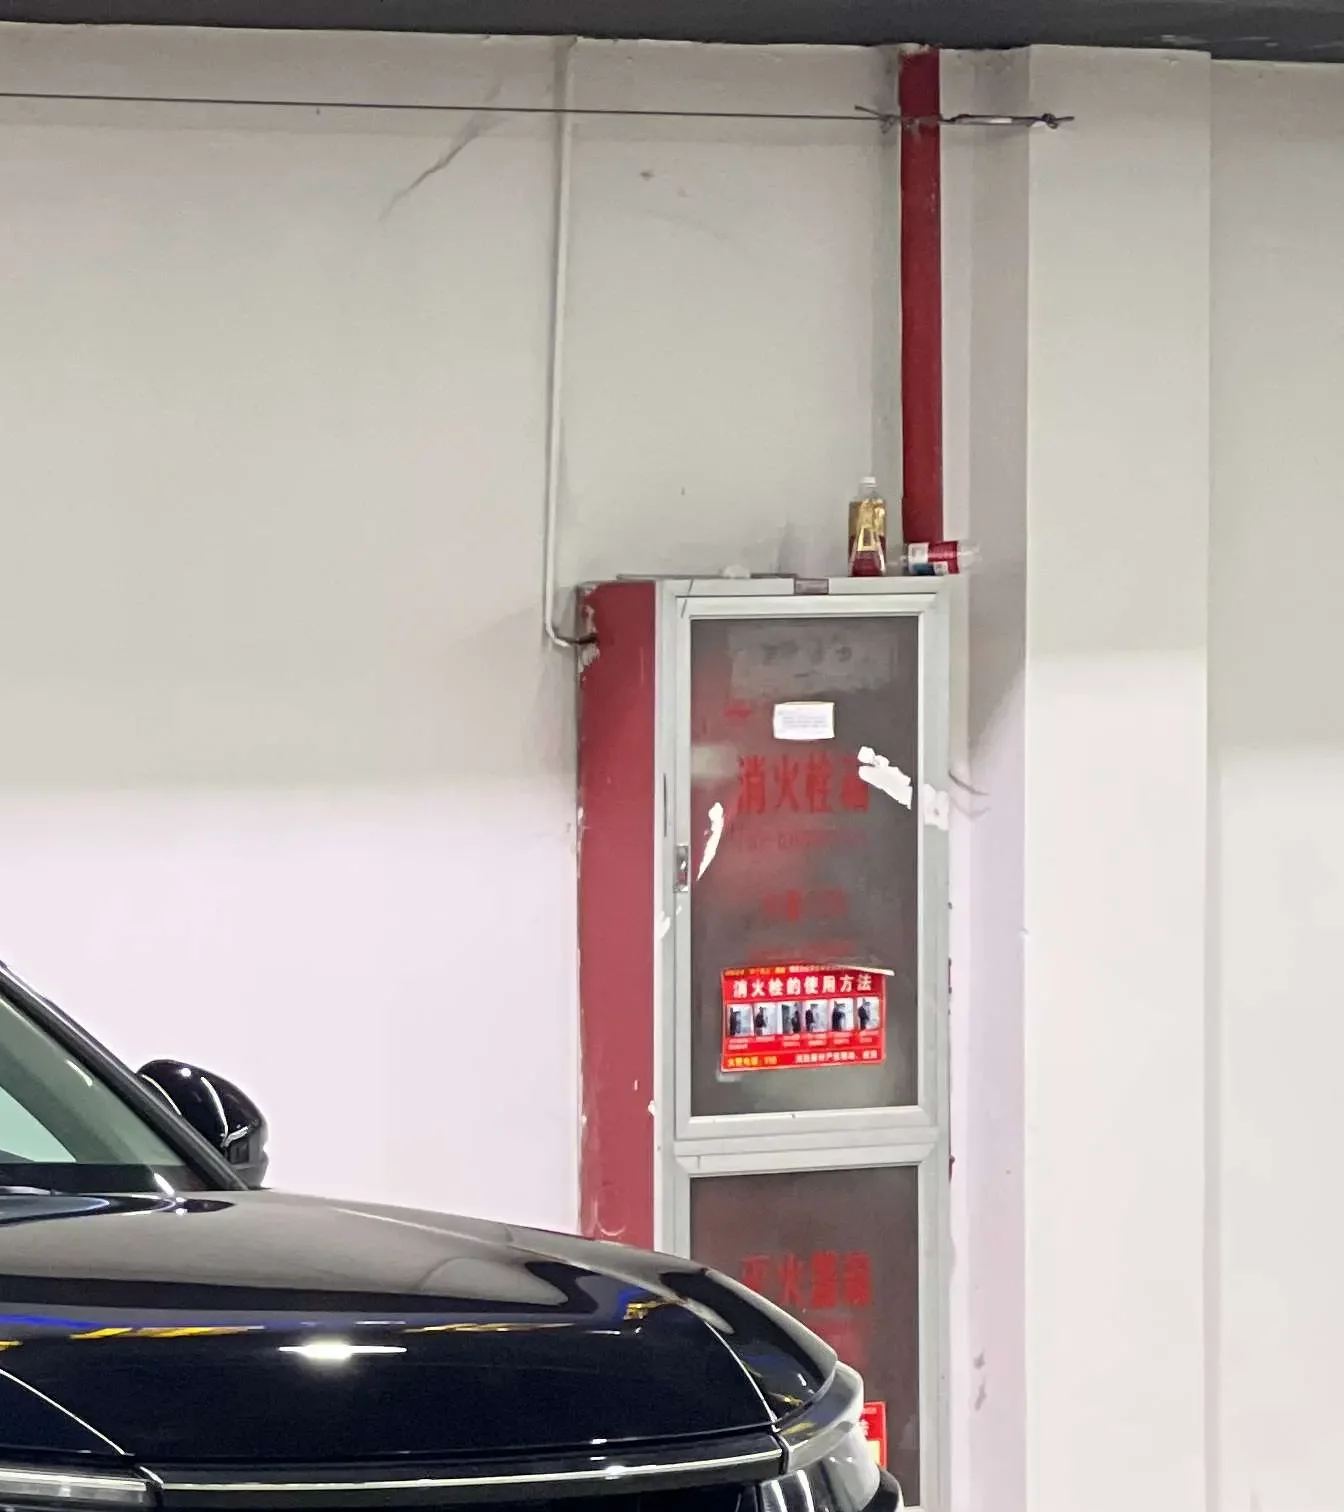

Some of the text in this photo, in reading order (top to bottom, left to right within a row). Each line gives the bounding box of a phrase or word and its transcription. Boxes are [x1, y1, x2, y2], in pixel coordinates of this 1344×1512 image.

[733, 974, 873, 999] 消火栓的使用方法
